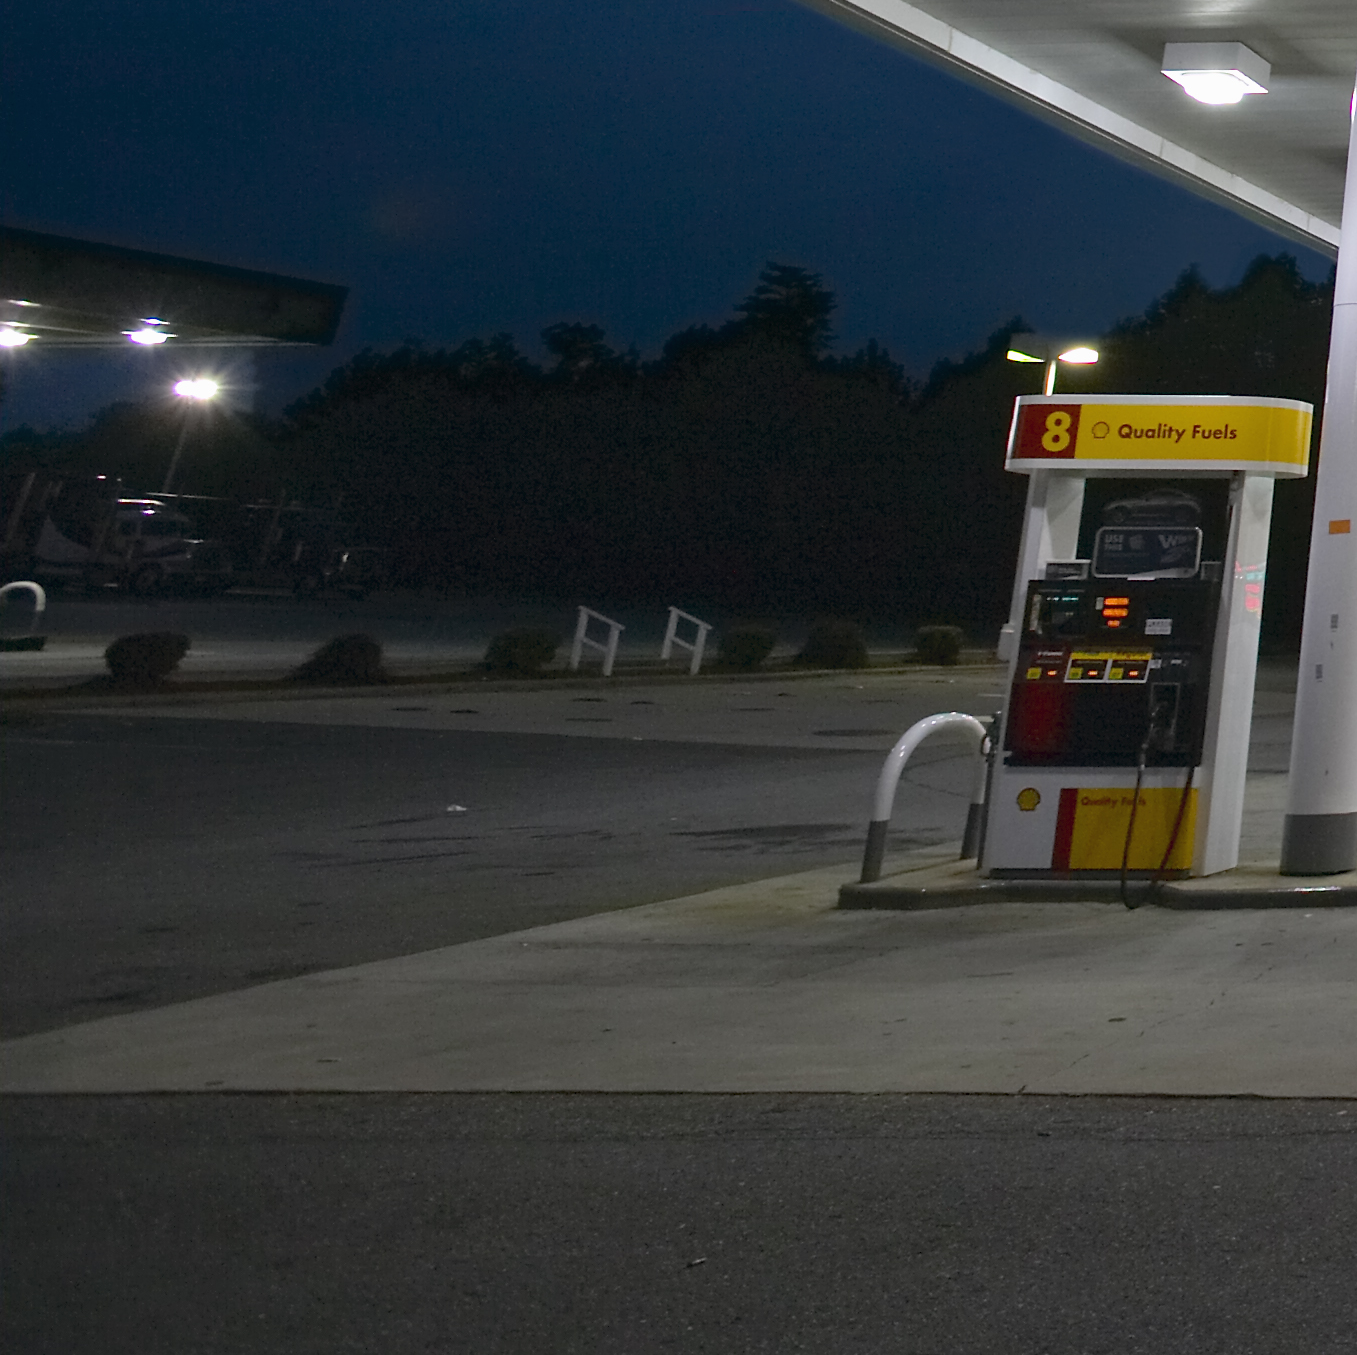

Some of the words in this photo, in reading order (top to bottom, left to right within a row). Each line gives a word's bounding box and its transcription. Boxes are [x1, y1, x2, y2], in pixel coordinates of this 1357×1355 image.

[1041, 411, 1072, 452] 8
[1117, 423, 1186, 444] Quality
[1191, 423, 1238, 440] Fuels
[1080, 796, 1119, 809] Quality
[1121, 796, 1147, 806] Fuls
